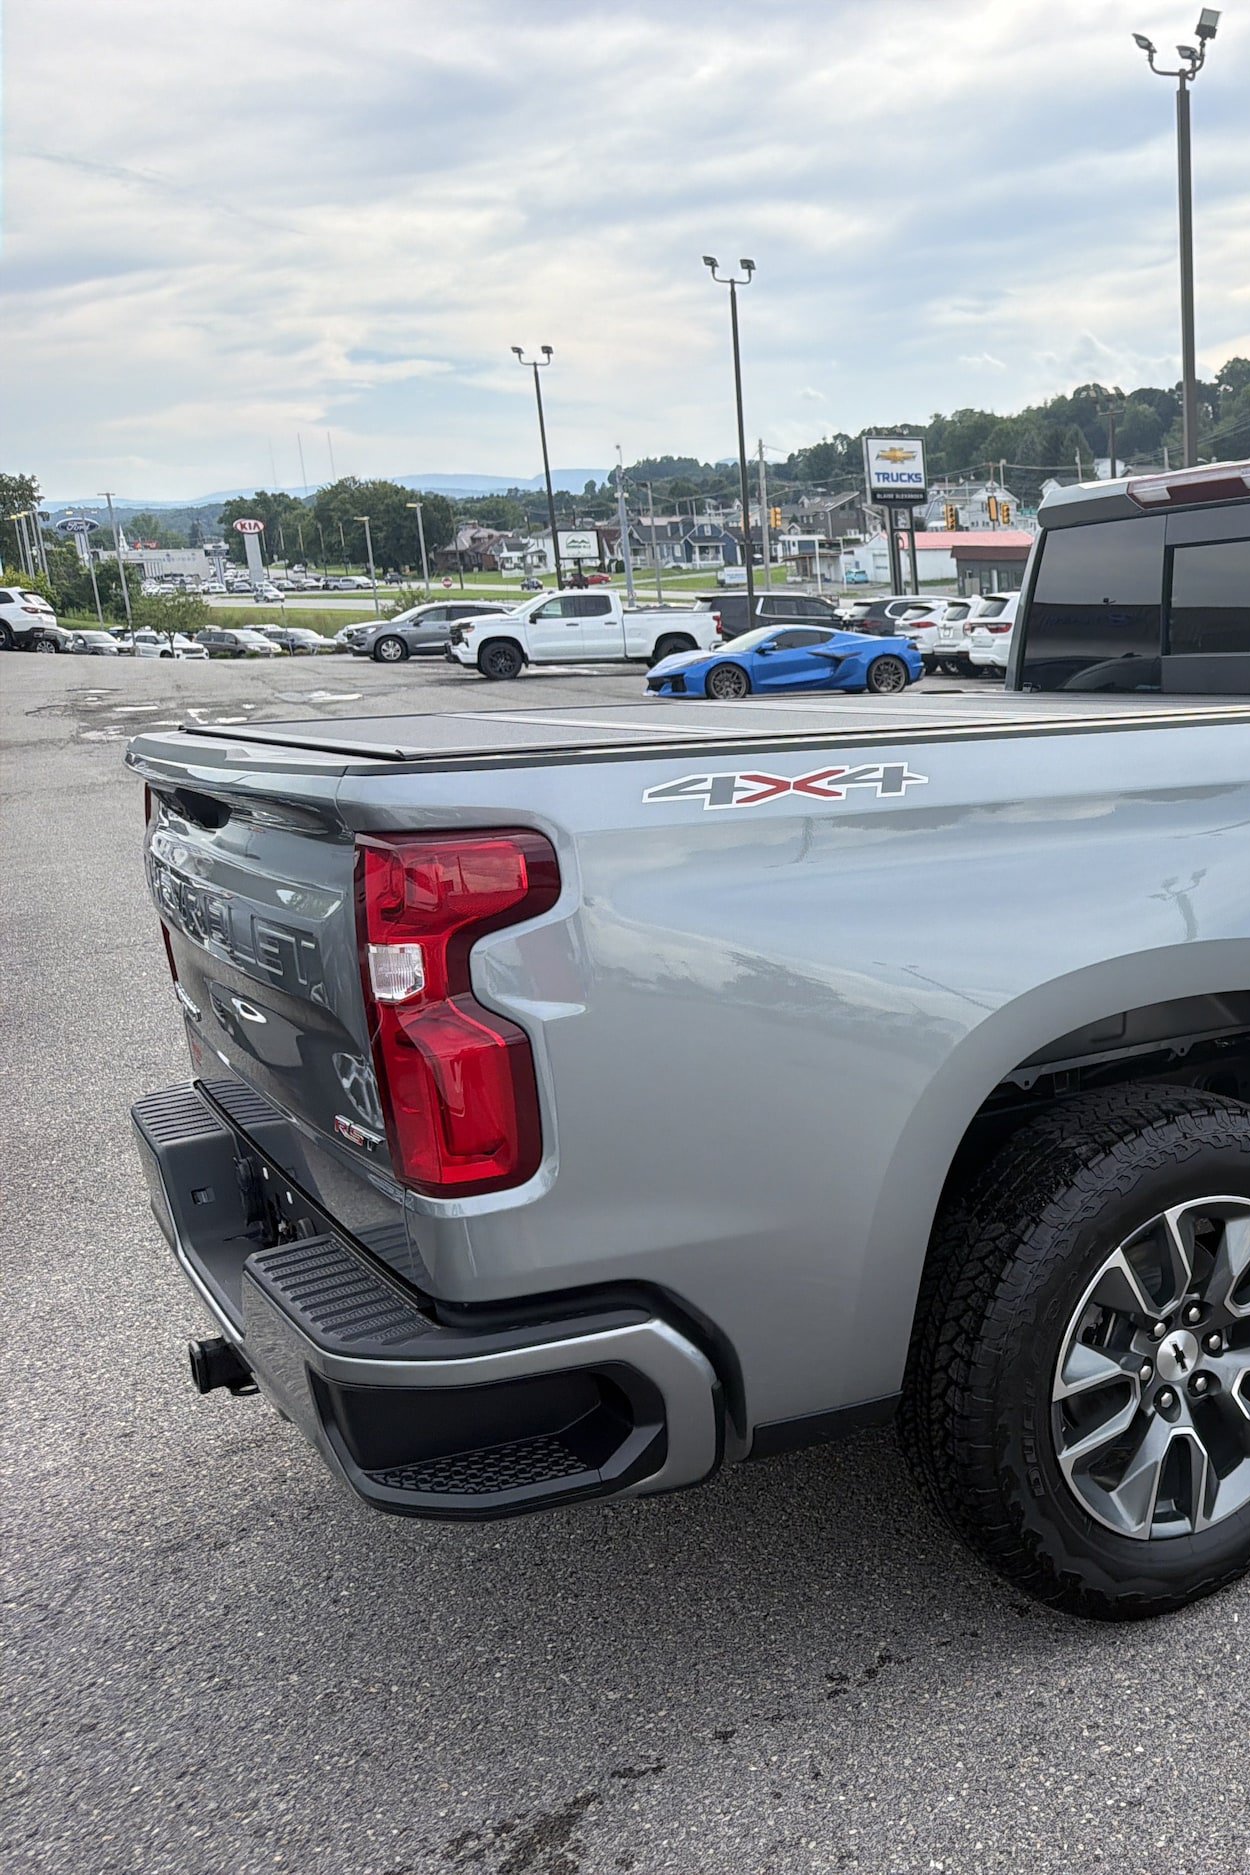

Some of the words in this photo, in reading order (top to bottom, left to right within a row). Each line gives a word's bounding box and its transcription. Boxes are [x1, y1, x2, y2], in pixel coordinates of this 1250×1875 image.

[874, 472, 922, 483] TRUCKS
[240, 522, 260, 530] KIA
[334, 1115, 386, 1152] RST
